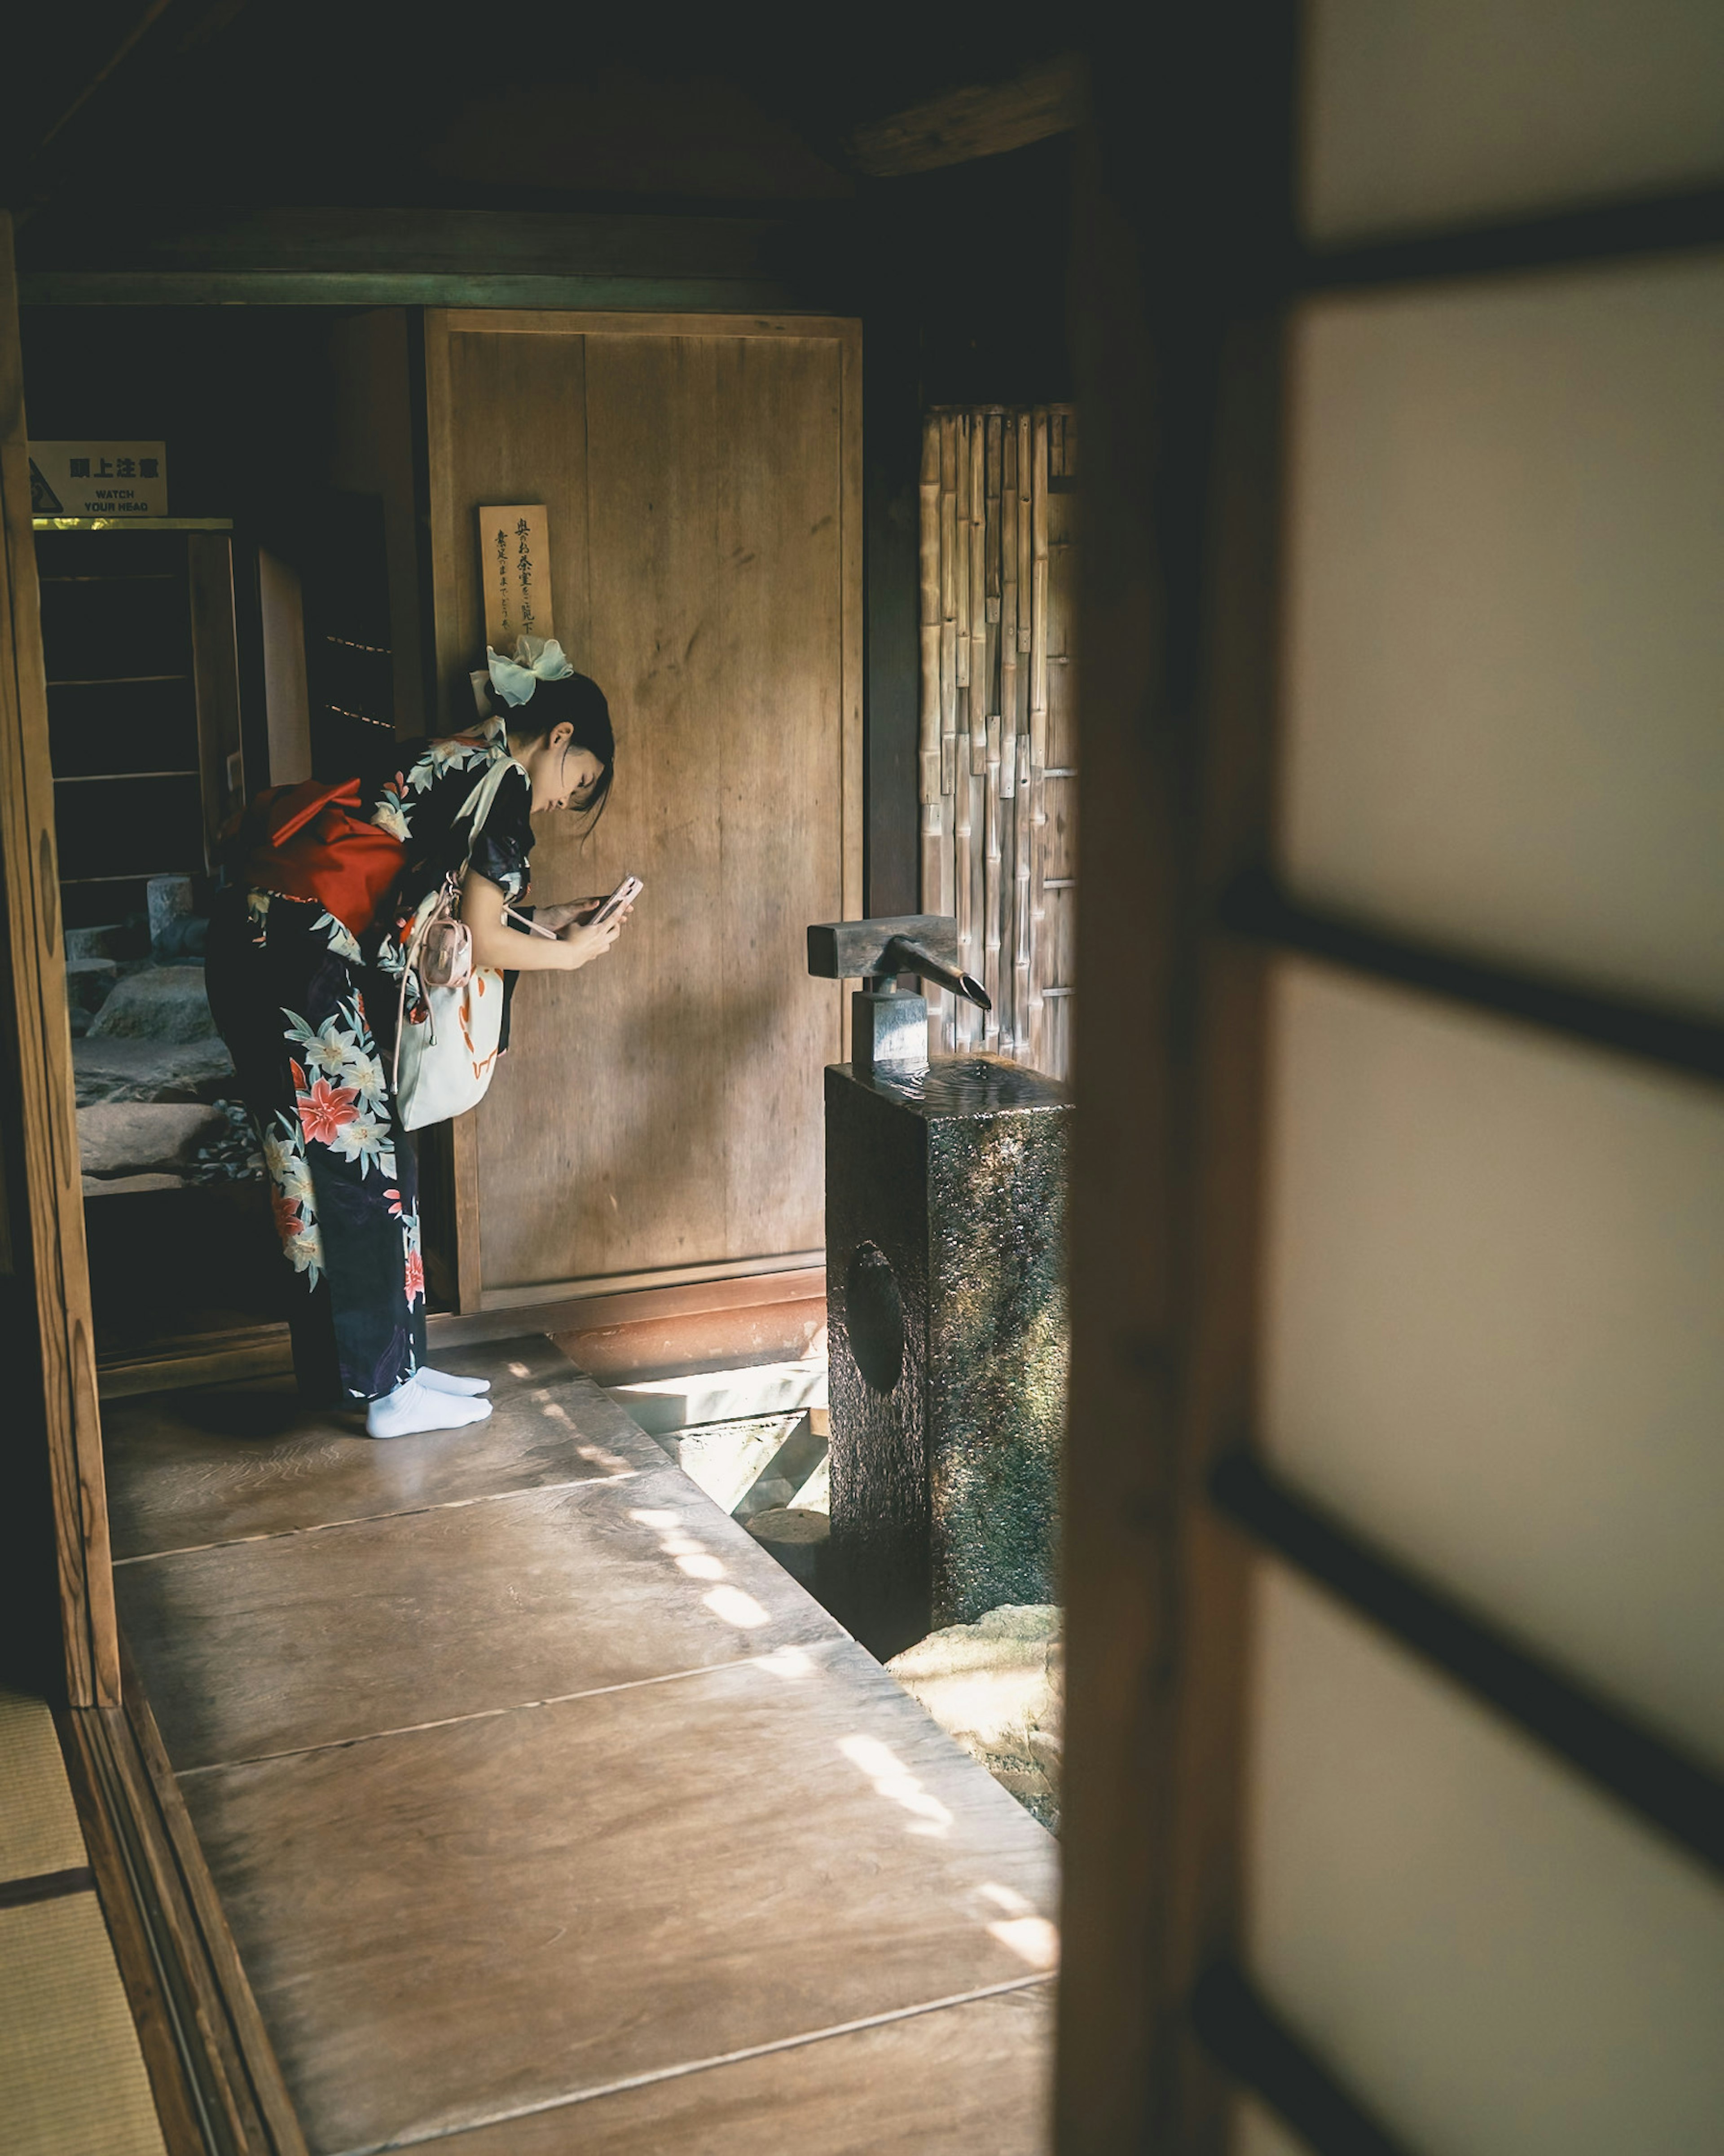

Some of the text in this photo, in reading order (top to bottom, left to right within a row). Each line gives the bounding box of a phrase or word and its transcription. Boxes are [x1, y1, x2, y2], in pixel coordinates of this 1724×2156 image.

[96, 490, 134, 499] WATCH
[84, 502, 148, 511] YOUR HEAD
